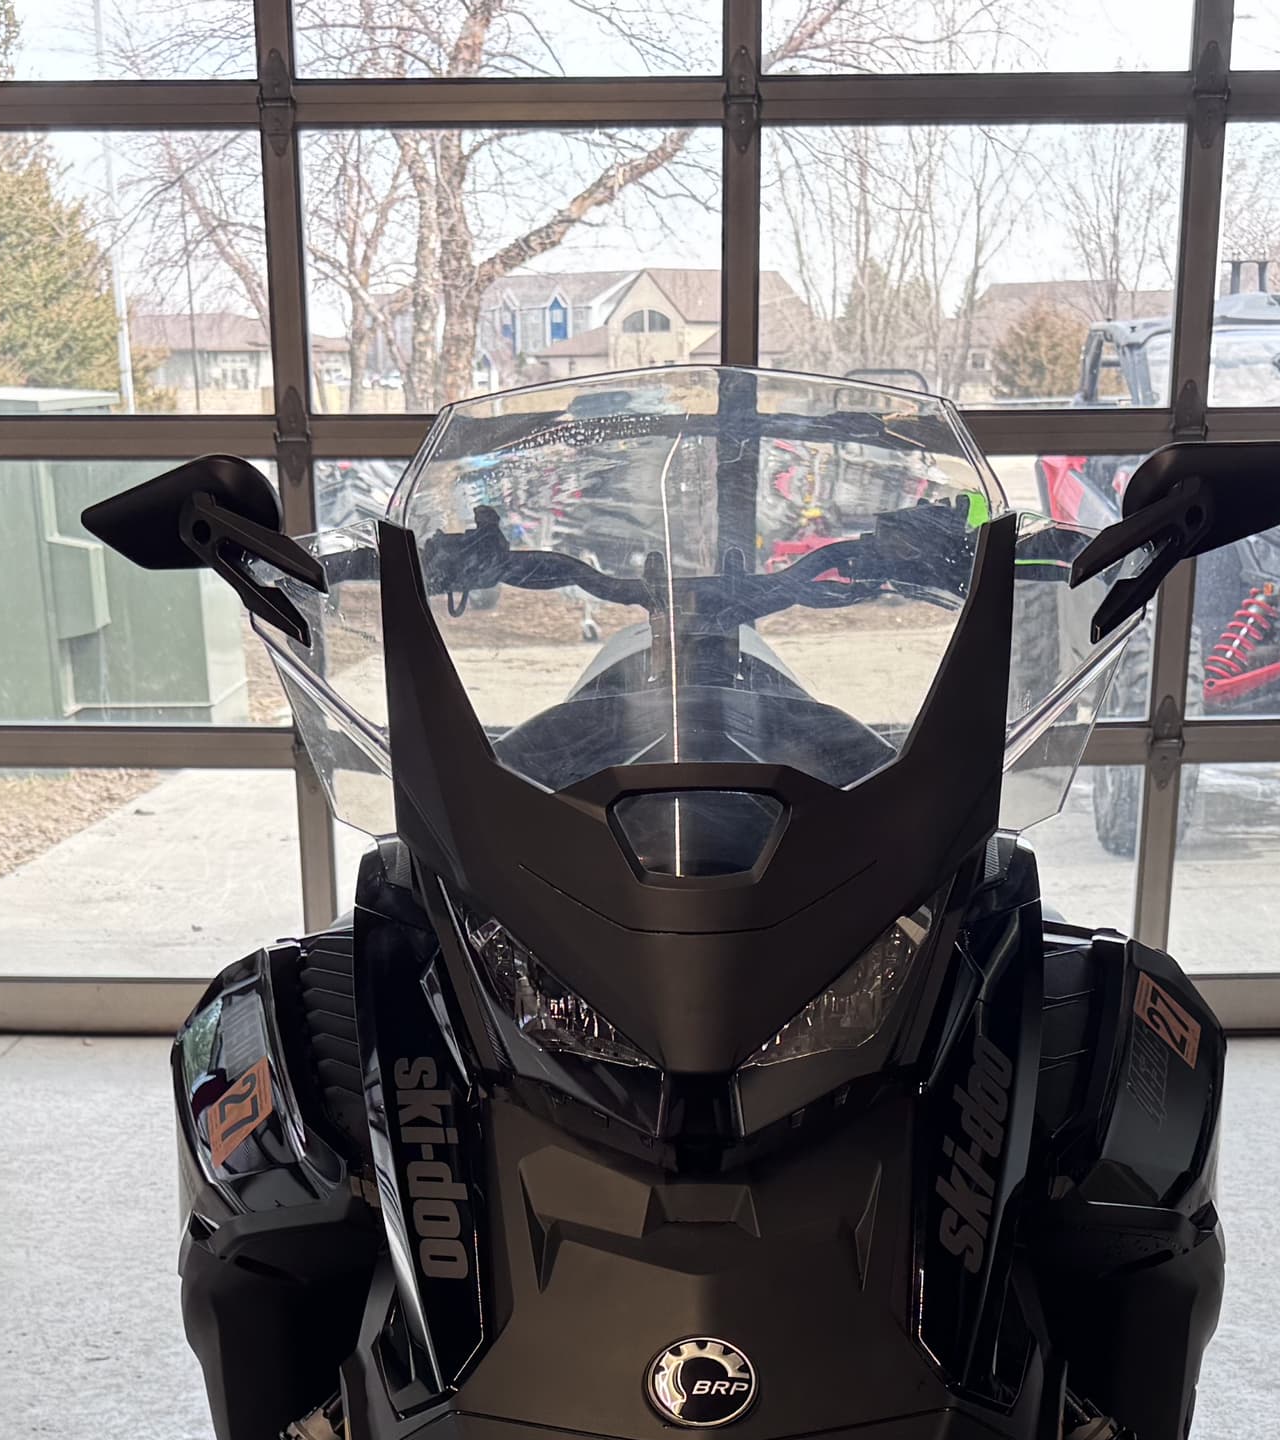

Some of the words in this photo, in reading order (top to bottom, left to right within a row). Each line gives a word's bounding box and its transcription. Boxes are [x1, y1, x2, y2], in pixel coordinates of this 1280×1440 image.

[1148, 985, 1189, 1054] 27
[219, 1072, 260, 1141] 27
[393, 1057, 469, 1280] ski-doo
[936, 1035, 1014, 1273] ski-doo
[691, 1379, 750, 1397] BRP
